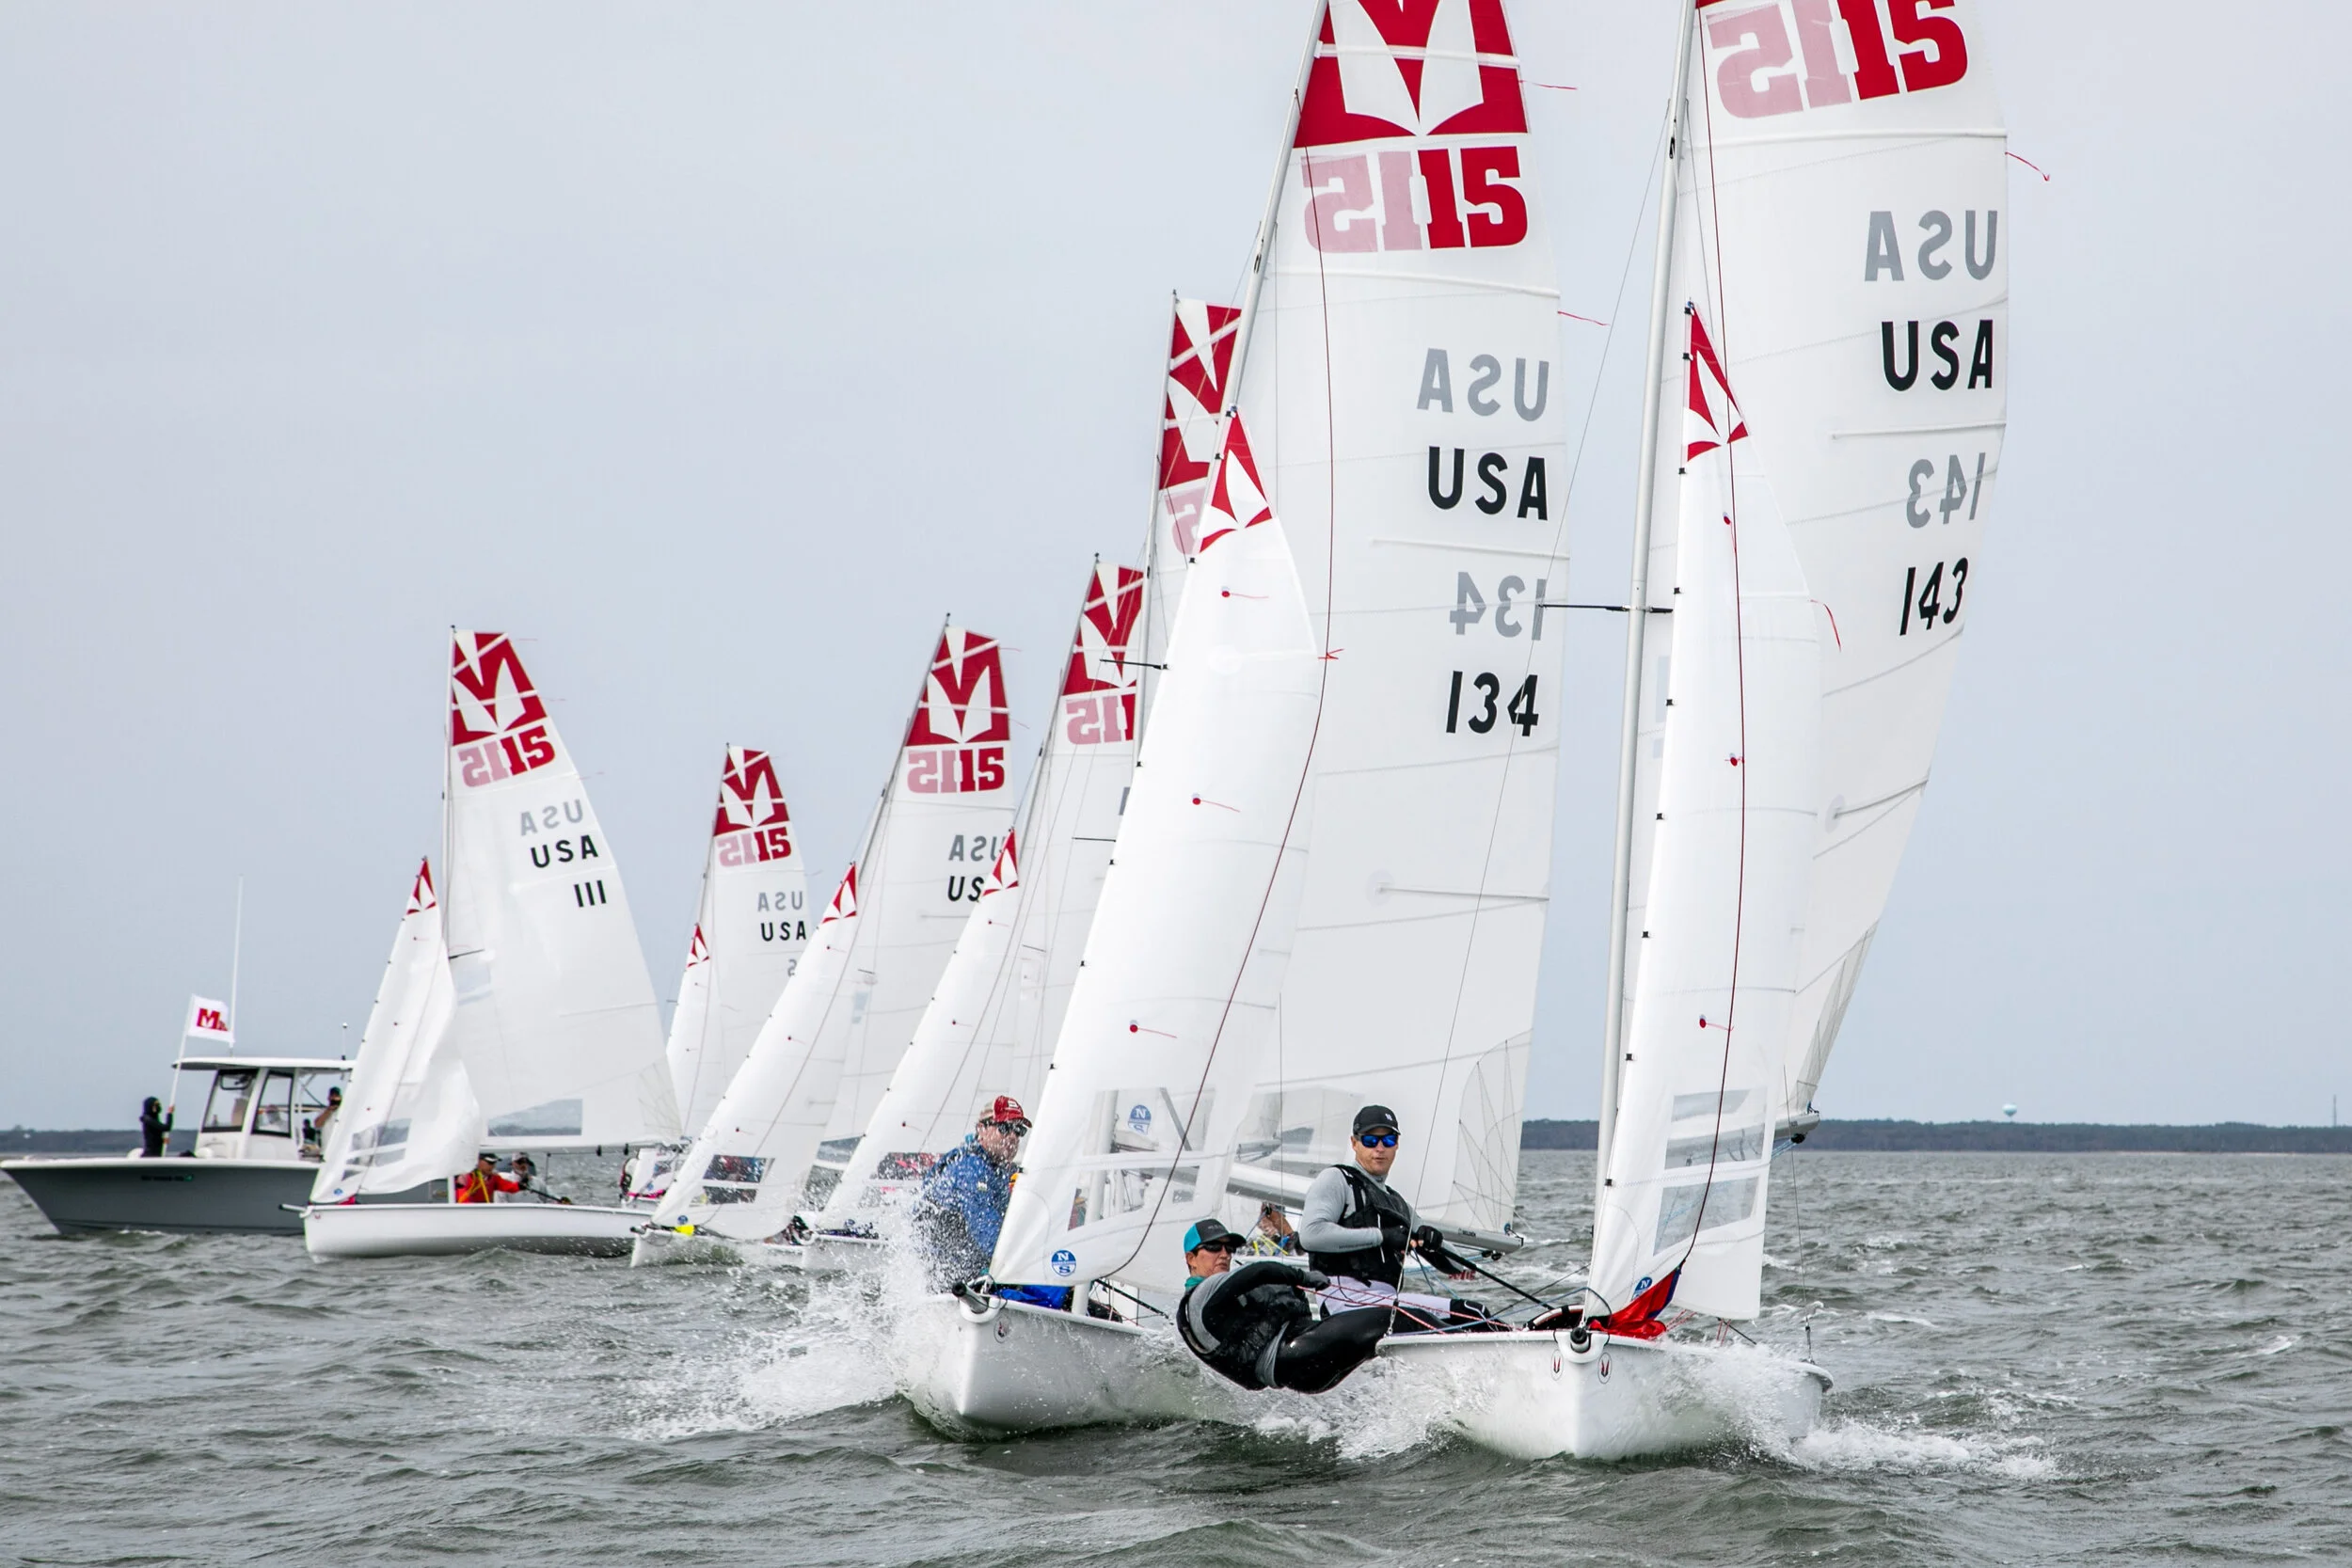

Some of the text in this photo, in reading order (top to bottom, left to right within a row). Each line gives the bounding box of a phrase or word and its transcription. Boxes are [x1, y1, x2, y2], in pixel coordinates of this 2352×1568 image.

[1836, 0, 1968, 101] 15
[1417, 146, 1528, 249] 15
[1882, 319, 1994, 391] USA
[1427, 446, 1549, 521] USA
[1899, 557, 1968, 636] 143
[1446, 670, 1539, 736] 134
[500, 724, 555, 775] 15
[960, 747, 1005, 793] 15
[531, 834, 598, 868] USA
[754, 827, 791, 862] 15
[573, 879, 607, 908] 111
[947, 876, 985, 902] US
[760, 921, 807, 942] USA
